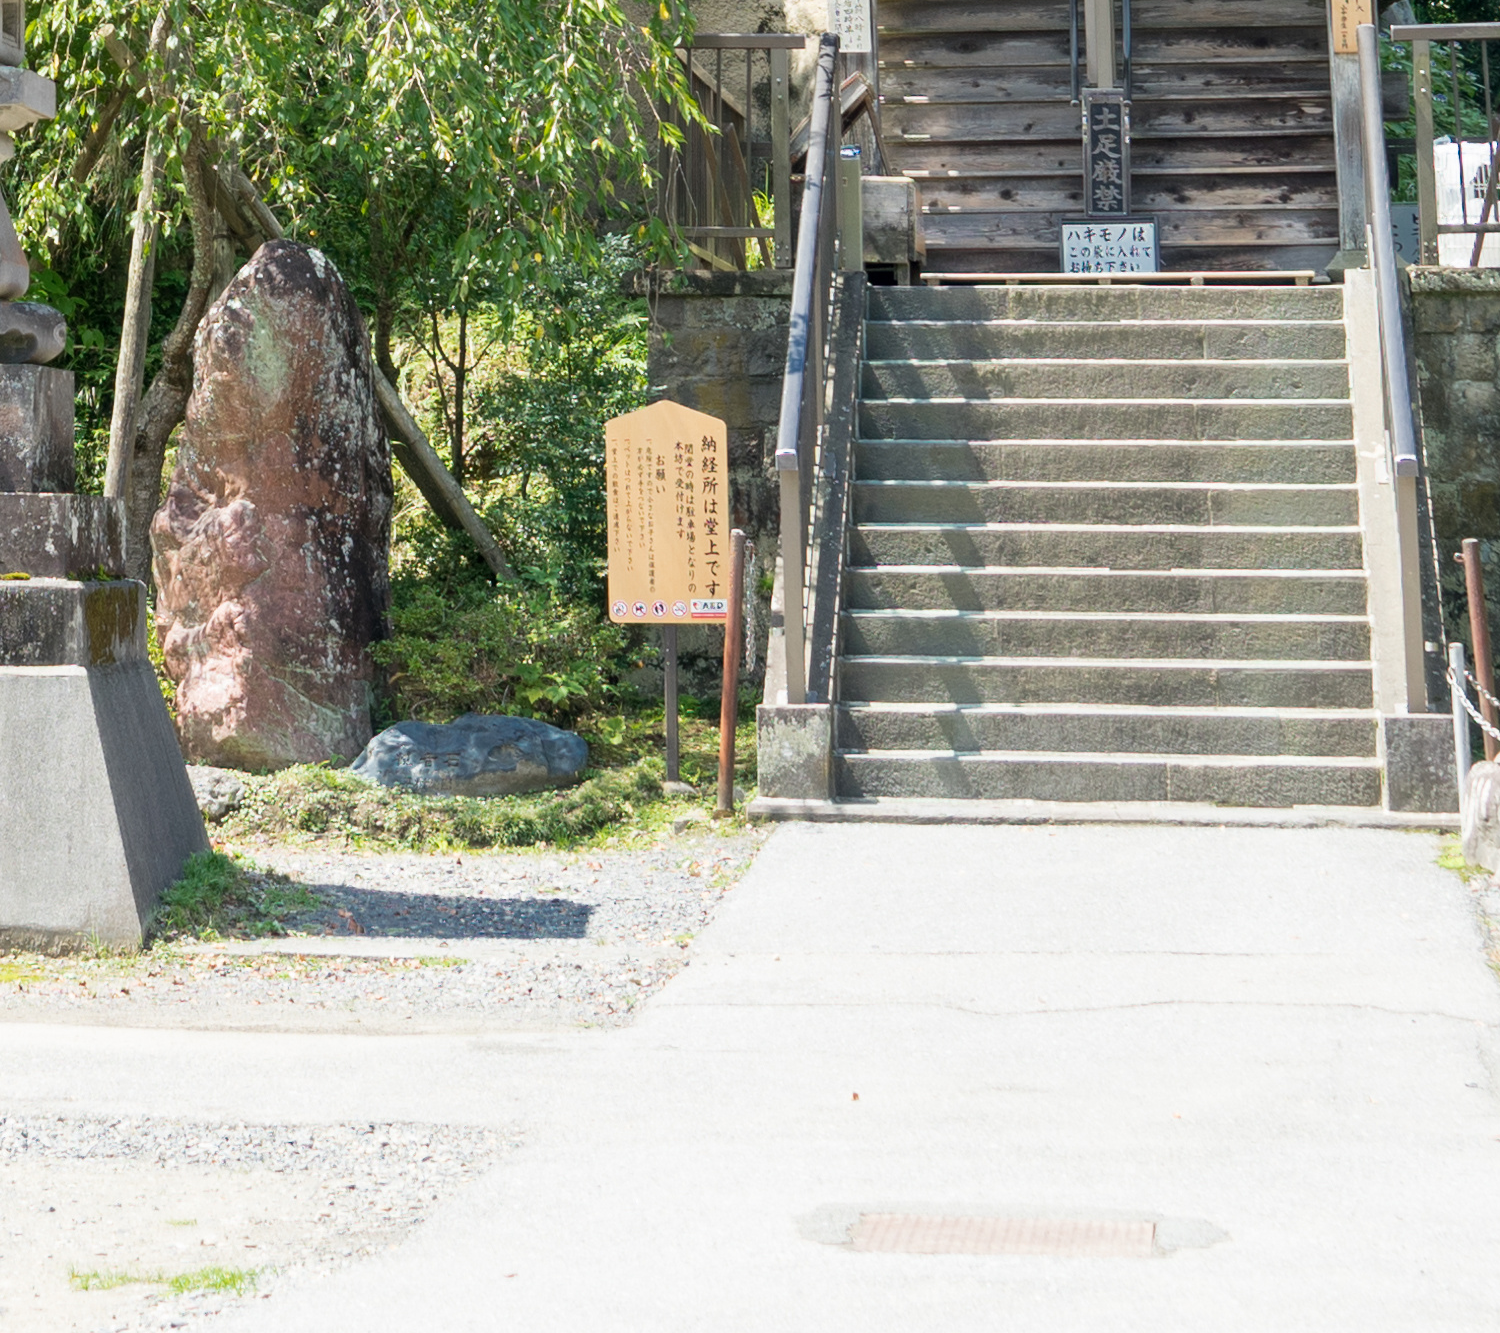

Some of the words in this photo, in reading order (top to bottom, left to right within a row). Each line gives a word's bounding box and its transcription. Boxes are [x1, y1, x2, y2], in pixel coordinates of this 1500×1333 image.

[1092, 107, 1122, 211] 土足厳禁
[1067, 227, 1146, 243] ハキモノは
[656, 455, 666, 494] お願い
[674, 441, 685, 539] 本坊で受付けます
[701, 435, 720, 598] 納経所は堂上です
[702, 602, 724, 610] AED
